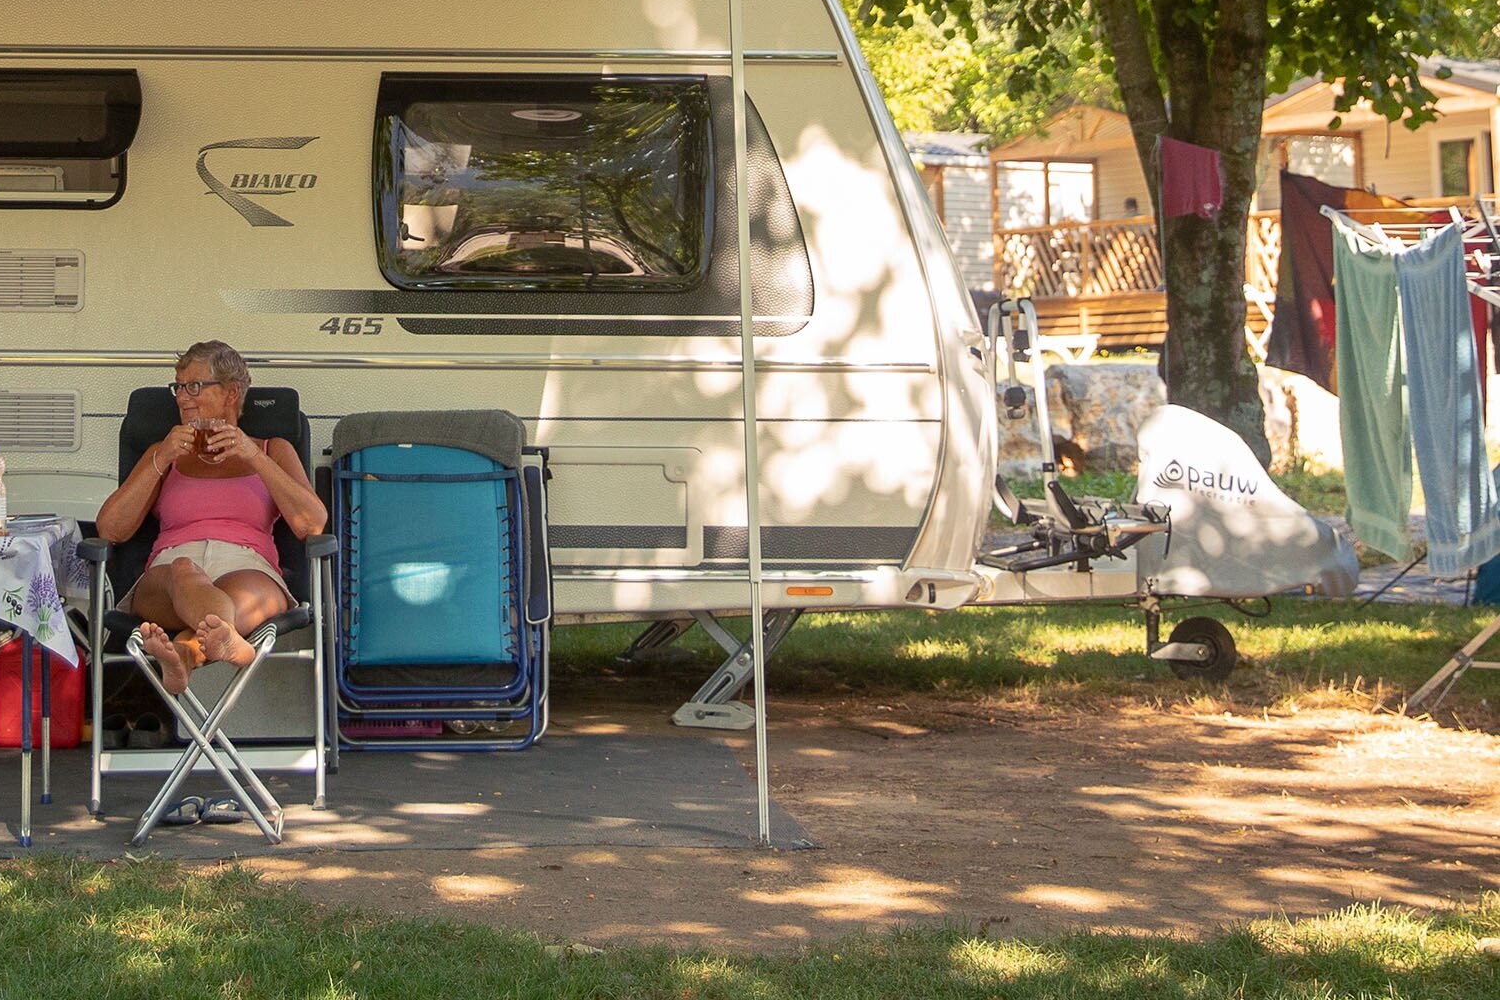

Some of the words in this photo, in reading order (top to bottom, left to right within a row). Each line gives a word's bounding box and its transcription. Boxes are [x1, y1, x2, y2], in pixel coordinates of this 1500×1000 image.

[230, 173, 318, 189] BIANCO
[319, 317, 384, 335] 465
[1188, 466, 1259, 495] pauw
